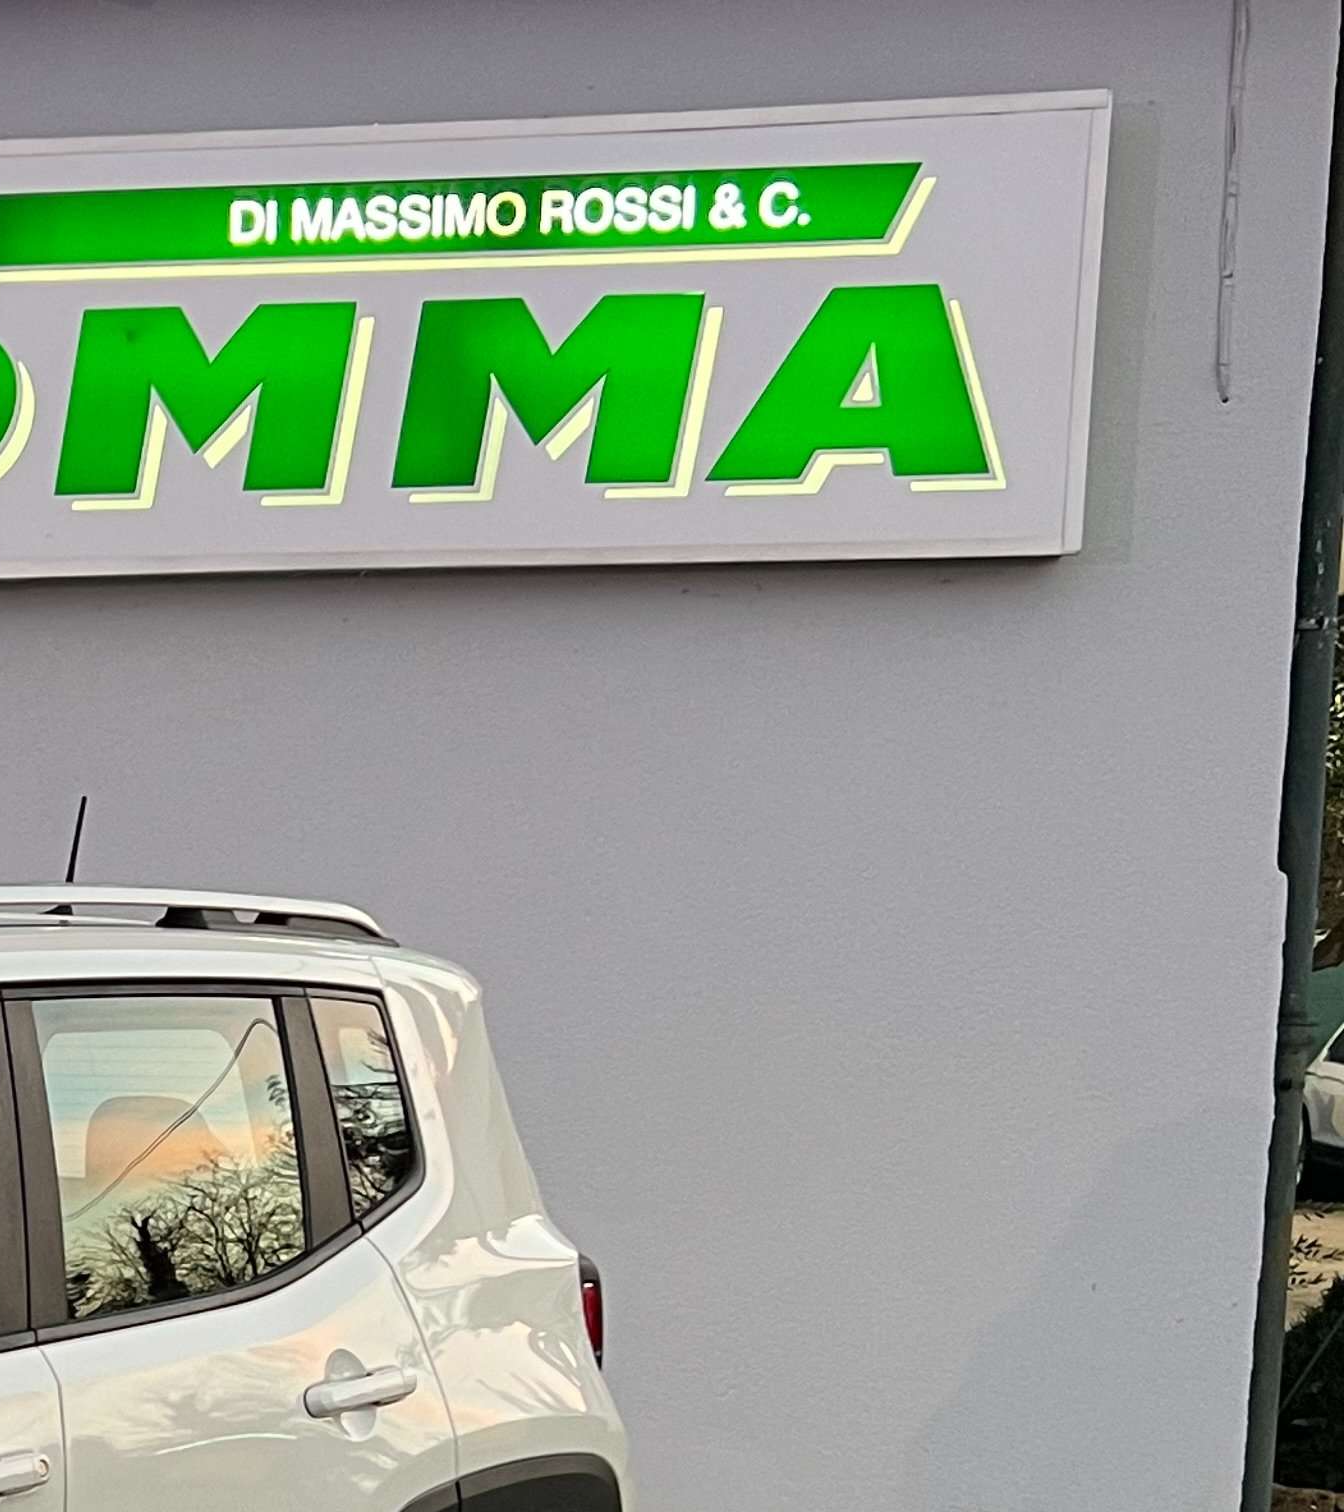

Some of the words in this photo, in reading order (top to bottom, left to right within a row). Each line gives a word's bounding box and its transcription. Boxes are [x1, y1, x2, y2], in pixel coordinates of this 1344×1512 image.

[228, 198, 278, 246] DI
[290, 191, 526, 245] MASSIMO
[539, 183, 697, 236] ROSSI
[708, 183, 748, 231] &
[758, 180, 812, 230] C.
